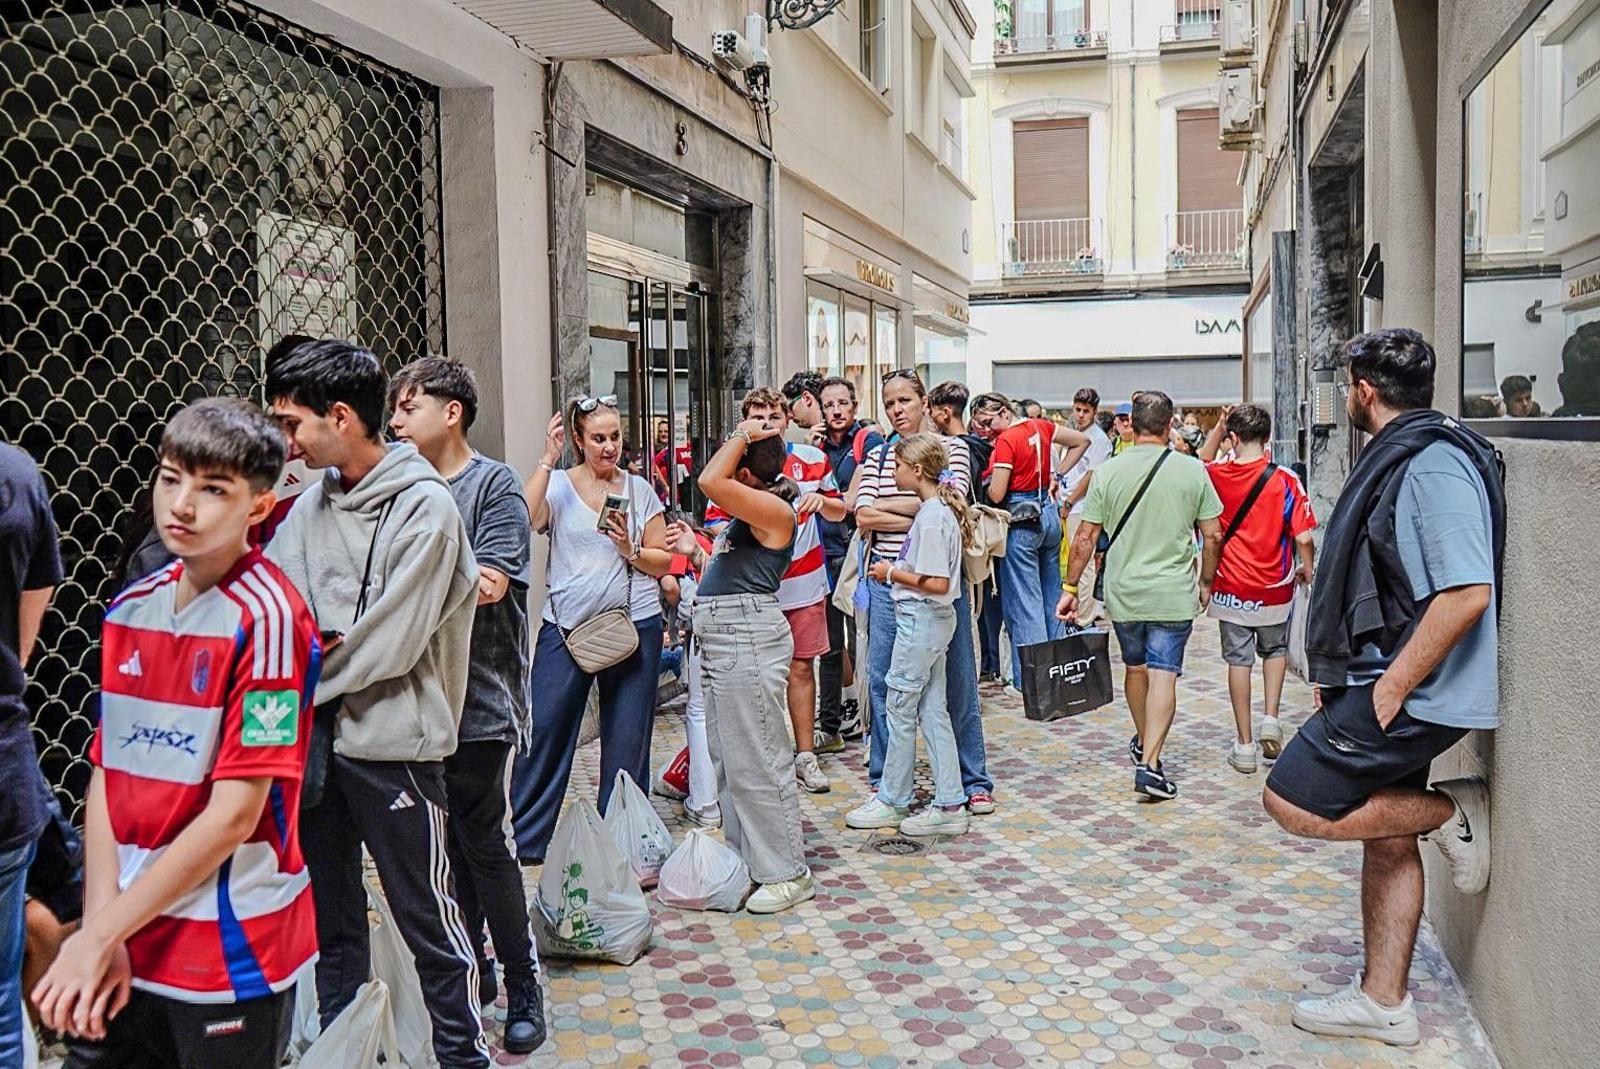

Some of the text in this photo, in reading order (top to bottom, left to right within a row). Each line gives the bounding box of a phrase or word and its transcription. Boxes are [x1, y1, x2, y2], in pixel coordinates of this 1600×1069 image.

[1028, 432, 1041, 472] 1
[1212, 591, 1264, 612] wiber
[1048, 655, 1096, 679] FIFTY
